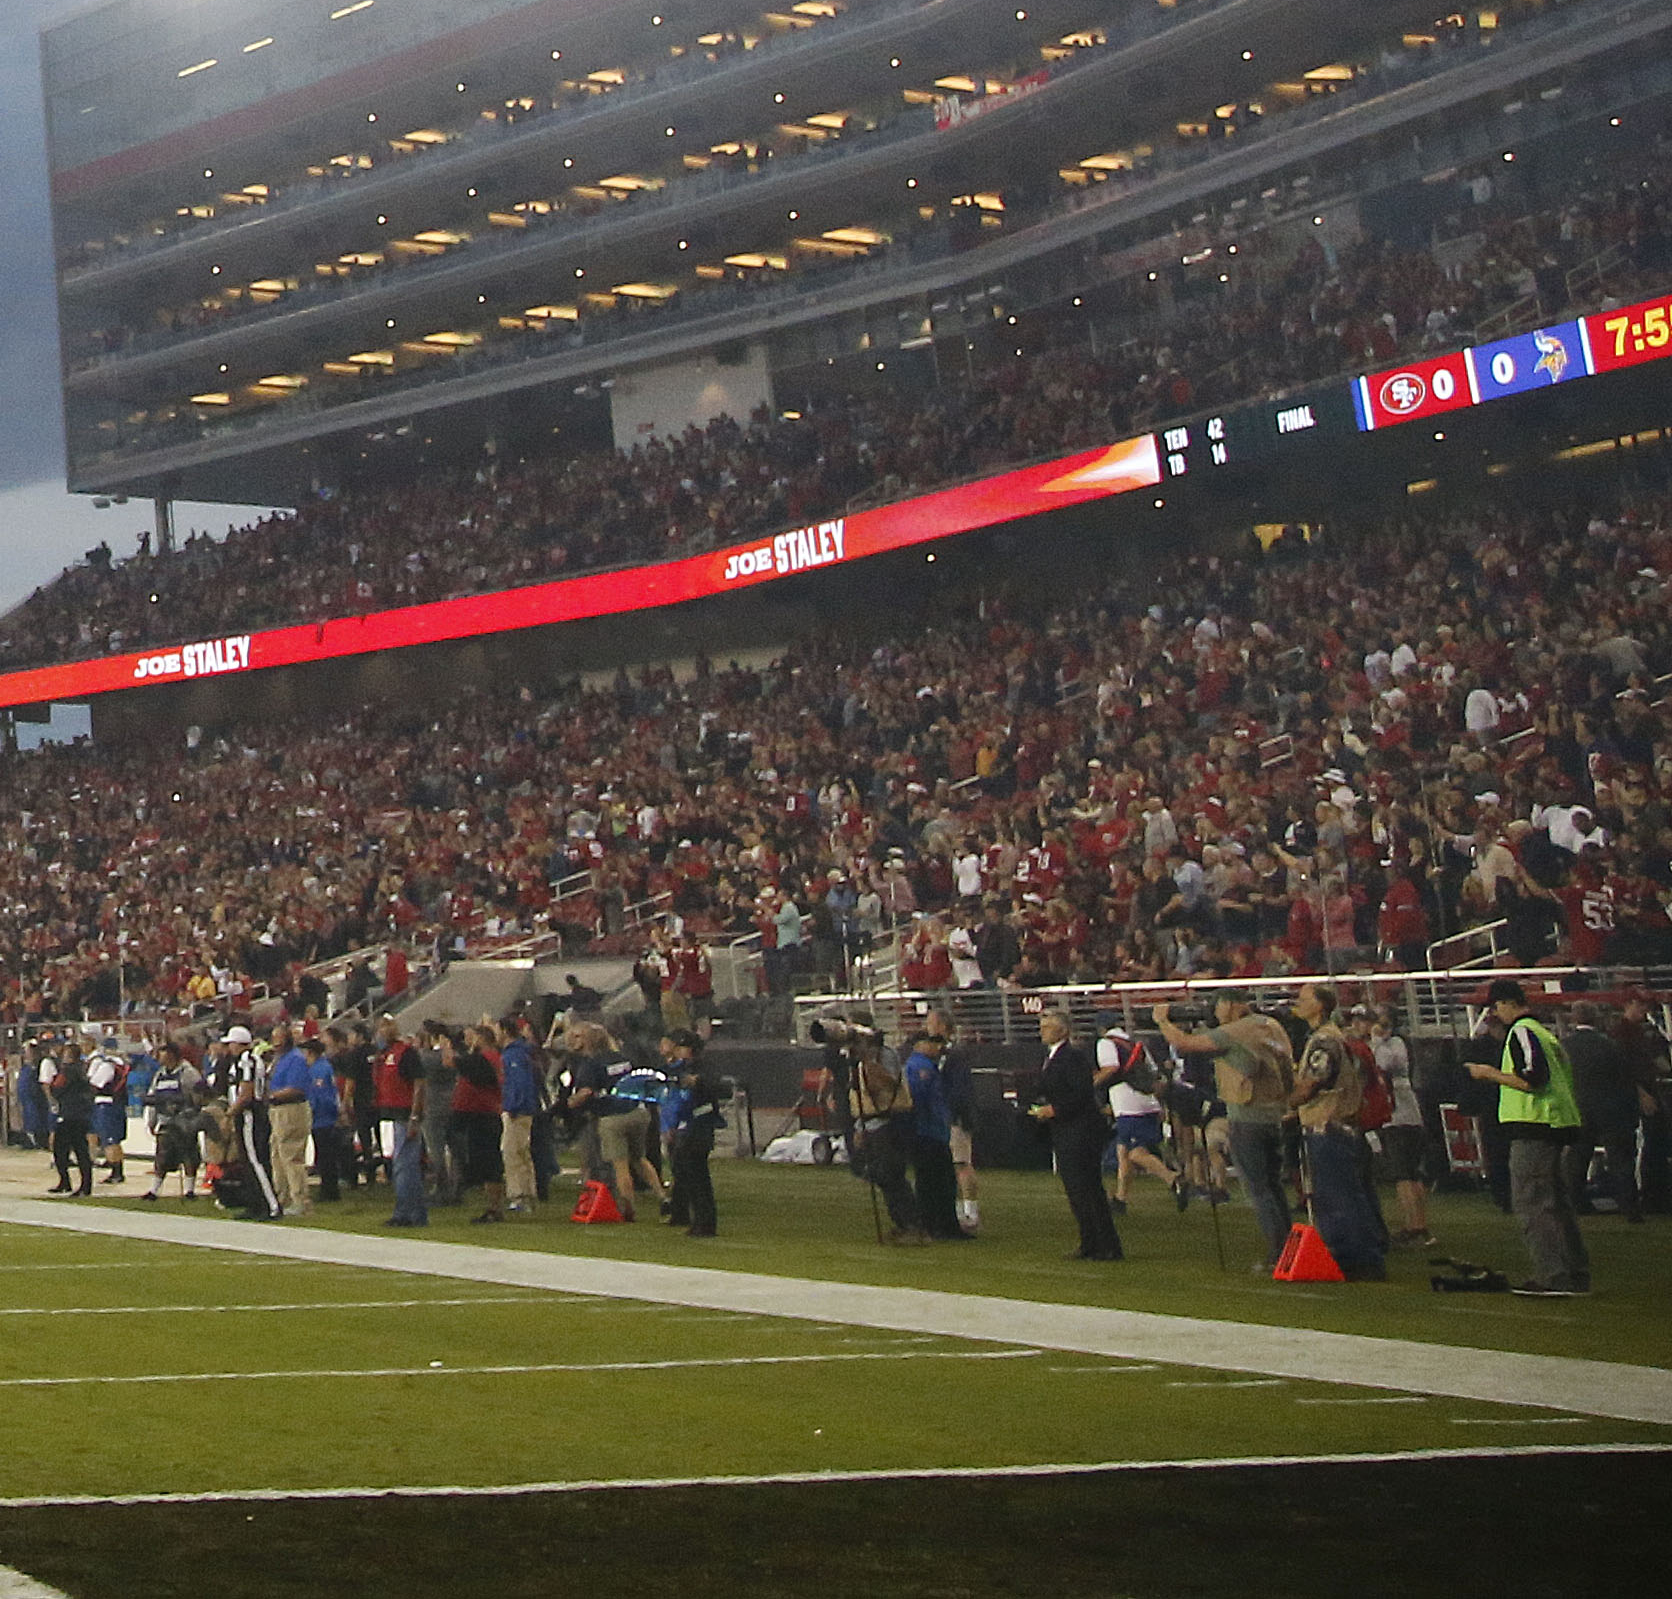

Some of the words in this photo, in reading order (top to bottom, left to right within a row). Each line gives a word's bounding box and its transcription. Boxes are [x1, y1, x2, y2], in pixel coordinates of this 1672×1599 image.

[1605, 303, 1672, 356] 7:5
[1432, 369, 1454, 400] 0
[1492, 352, 1514, 384] 0
[1164, 427, 1189, 451] TEN
[1207, 417, 1224, 440] 42
[1277, 405, 1315, 433] FINAL
[725, 547, 772, 579] JOE
[774, 518, 844, 574] STALEY
[134, 654, 181, 678] JOE
[182, 635, 250, 676] STALEY
